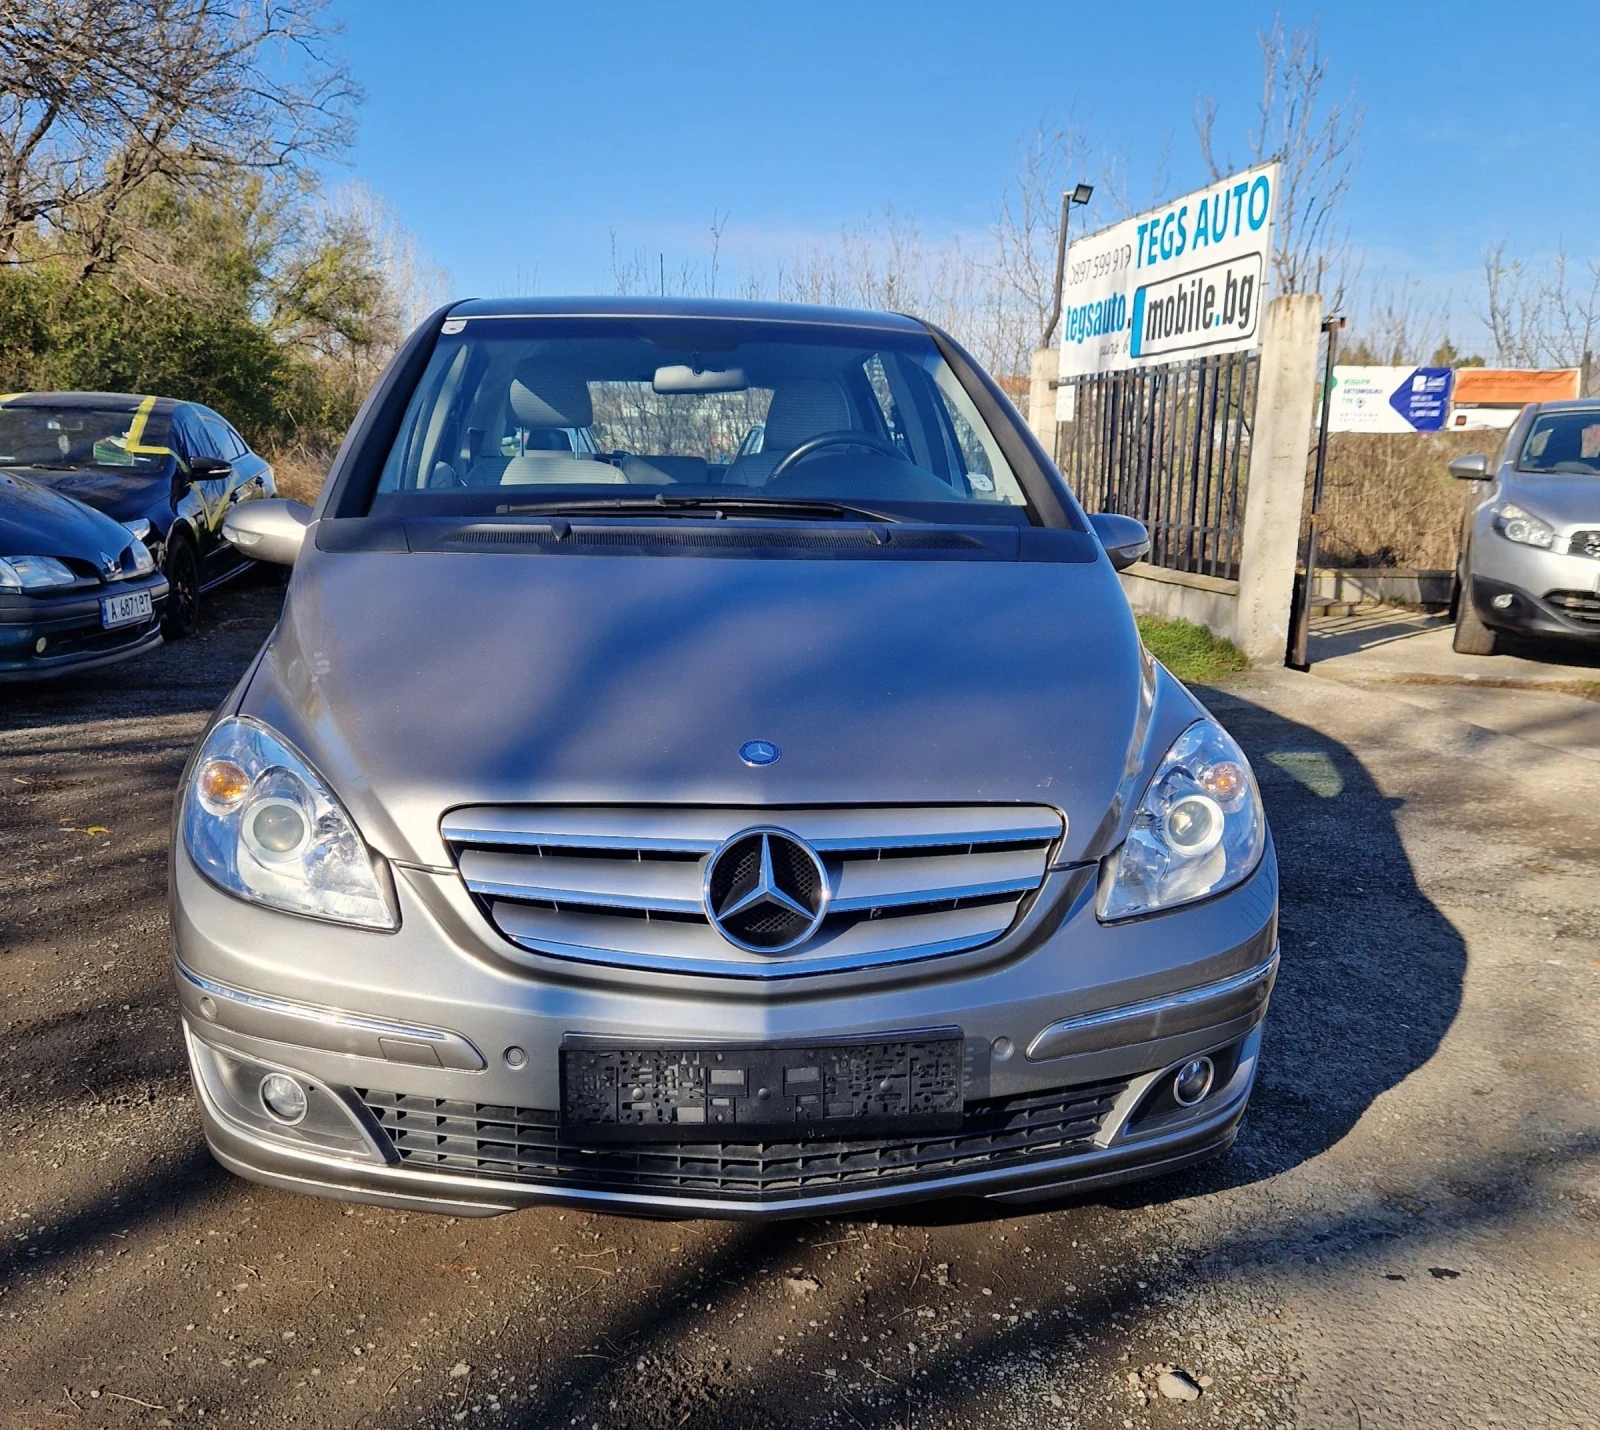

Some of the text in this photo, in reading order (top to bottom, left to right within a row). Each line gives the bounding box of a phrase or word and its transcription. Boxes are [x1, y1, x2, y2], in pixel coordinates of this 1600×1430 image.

[1136, 175, 1270, 269] TEGS AUTO
[1145, 269, 1254, 342] mobile.bg
